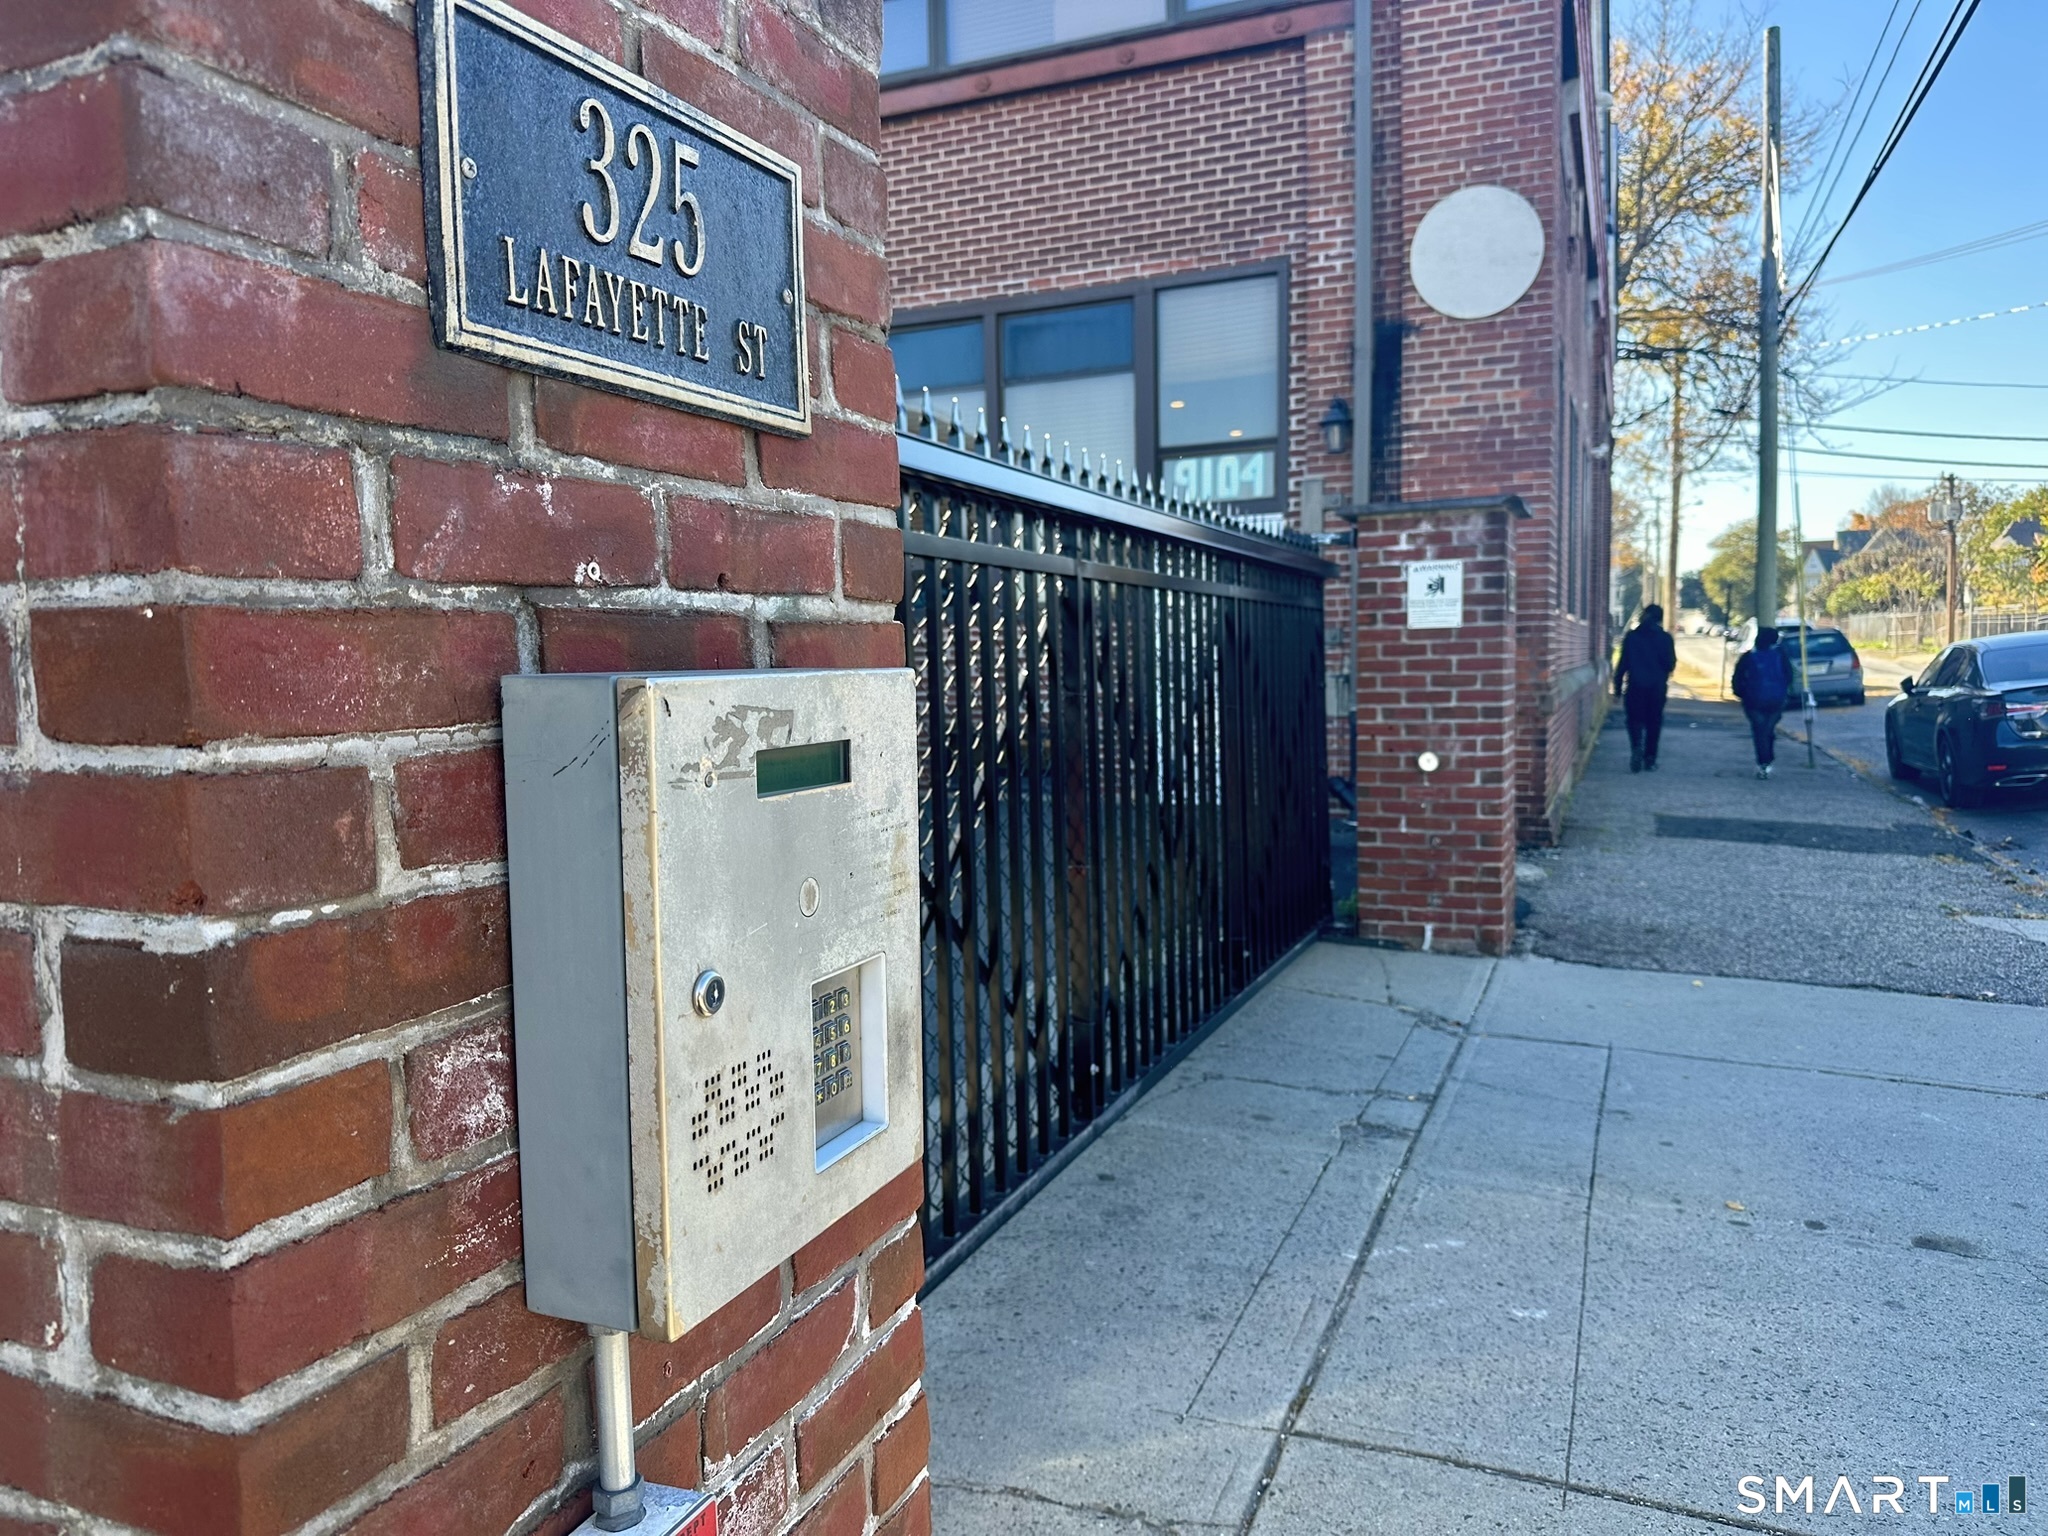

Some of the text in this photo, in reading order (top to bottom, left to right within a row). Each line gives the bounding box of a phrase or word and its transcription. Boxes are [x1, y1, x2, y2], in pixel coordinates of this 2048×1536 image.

[579, 98, 707, 277] 325
[501, 235, 768, 380] LAFAYETTE ST
[1419, 562, 1459, 572] WARNING
